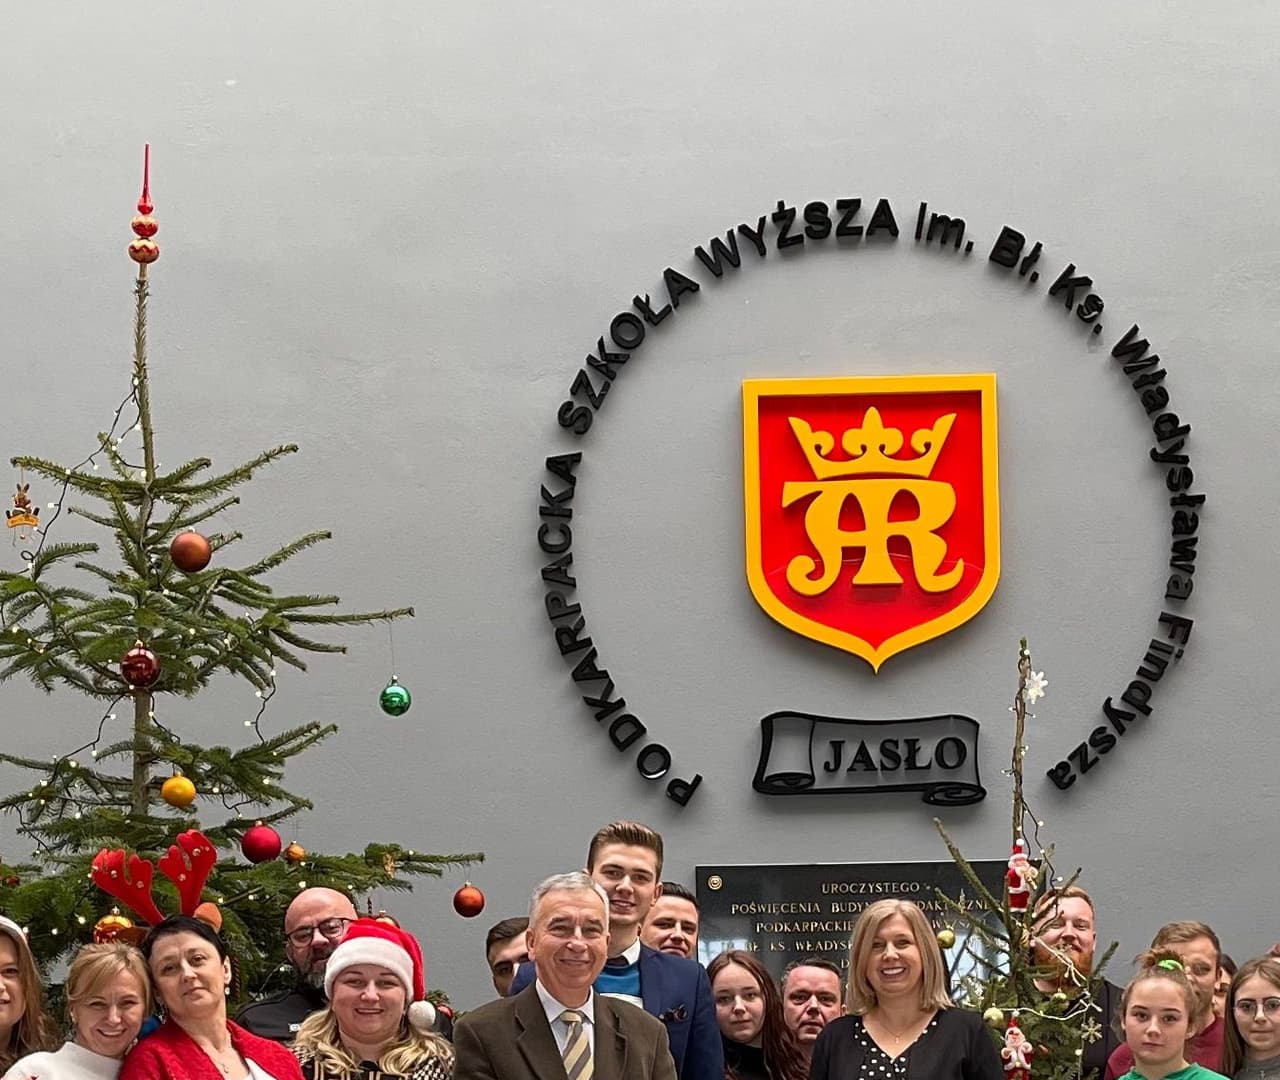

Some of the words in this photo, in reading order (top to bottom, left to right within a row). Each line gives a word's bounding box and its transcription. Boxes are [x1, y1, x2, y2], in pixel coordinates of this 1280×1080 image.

[693, 198, 901, 279] WYŻSZA
[1048, 262, 1105, 336] Ks.
[557, 266, 701, 436] SZKOŁA
[1111, 322, 1207, 602] Władysława
[537, 451, 704, 808] PODKARPACKA
[1046, 611, 1194, 792] Findysza
[823, 735, 968, 775] JASŁO
[756, 920, 854, 933] PODKARPACKIE
[821, 881, 920, 895] UROCZYSTEGO
